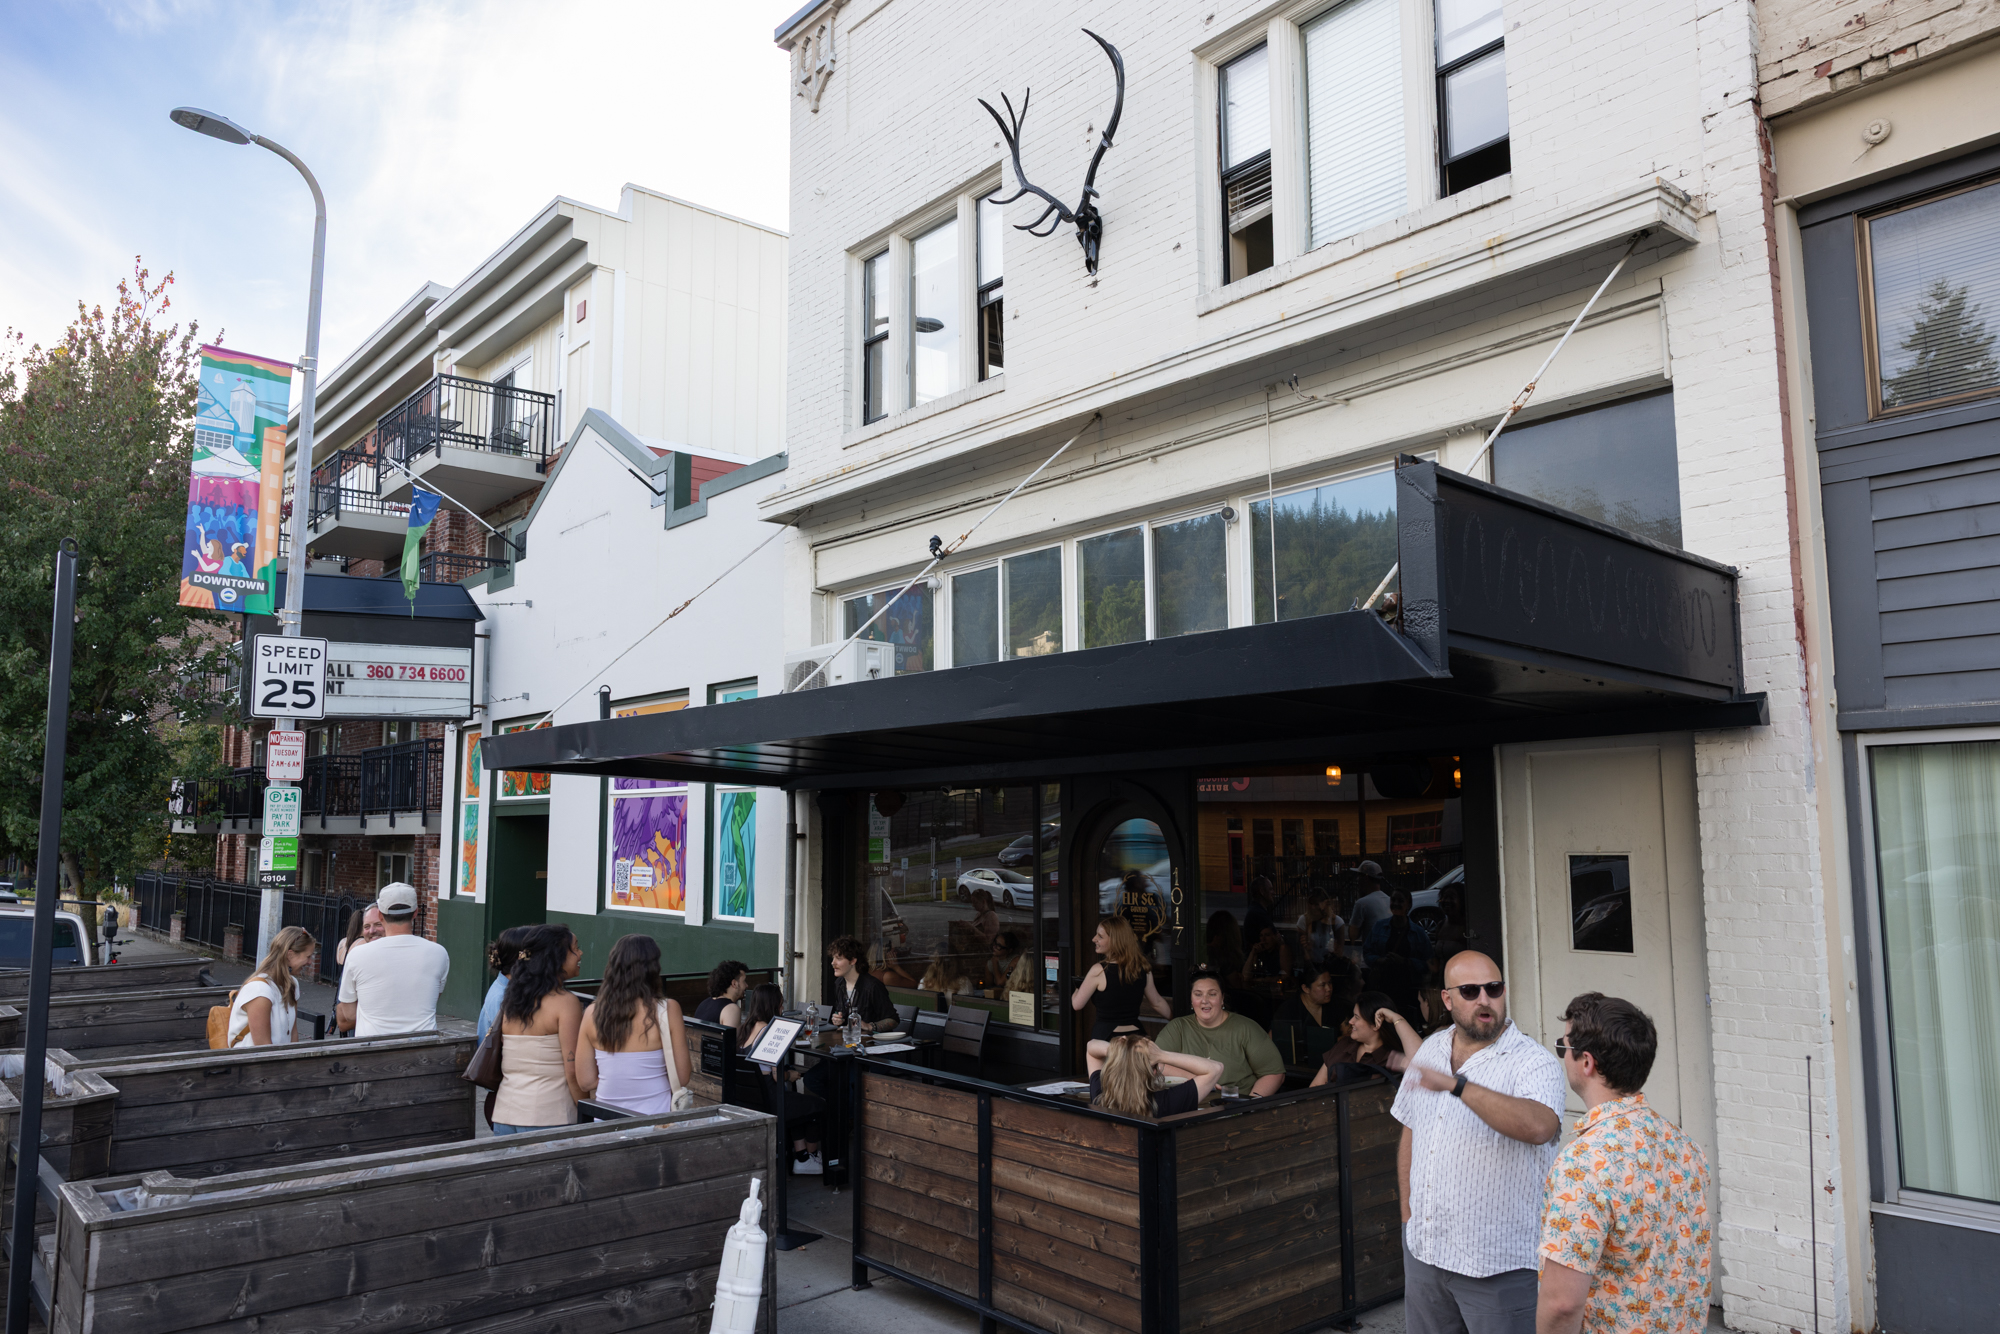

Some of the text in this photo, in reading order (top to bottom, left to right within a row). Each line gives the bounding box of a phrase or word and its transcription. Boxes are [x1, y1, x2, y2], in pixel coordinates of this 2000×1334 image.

[193, 573, 266, 591] DOWNTOWN
[262, 645, 321, 659] SPEED
[267, 661, 314, 676] LIMIT
[326, 663, 466, 681] ALL 360 734 6600
[261, 678, 316, 710] 25
[326, 681, 345, 695] NT
[270, 733, 303, 743] NO PARKING
[274, 749, 299, 757] TUESDAY
[261, 874, 287, 882] 49104
[1122, 891, 1139, 906] ELK
